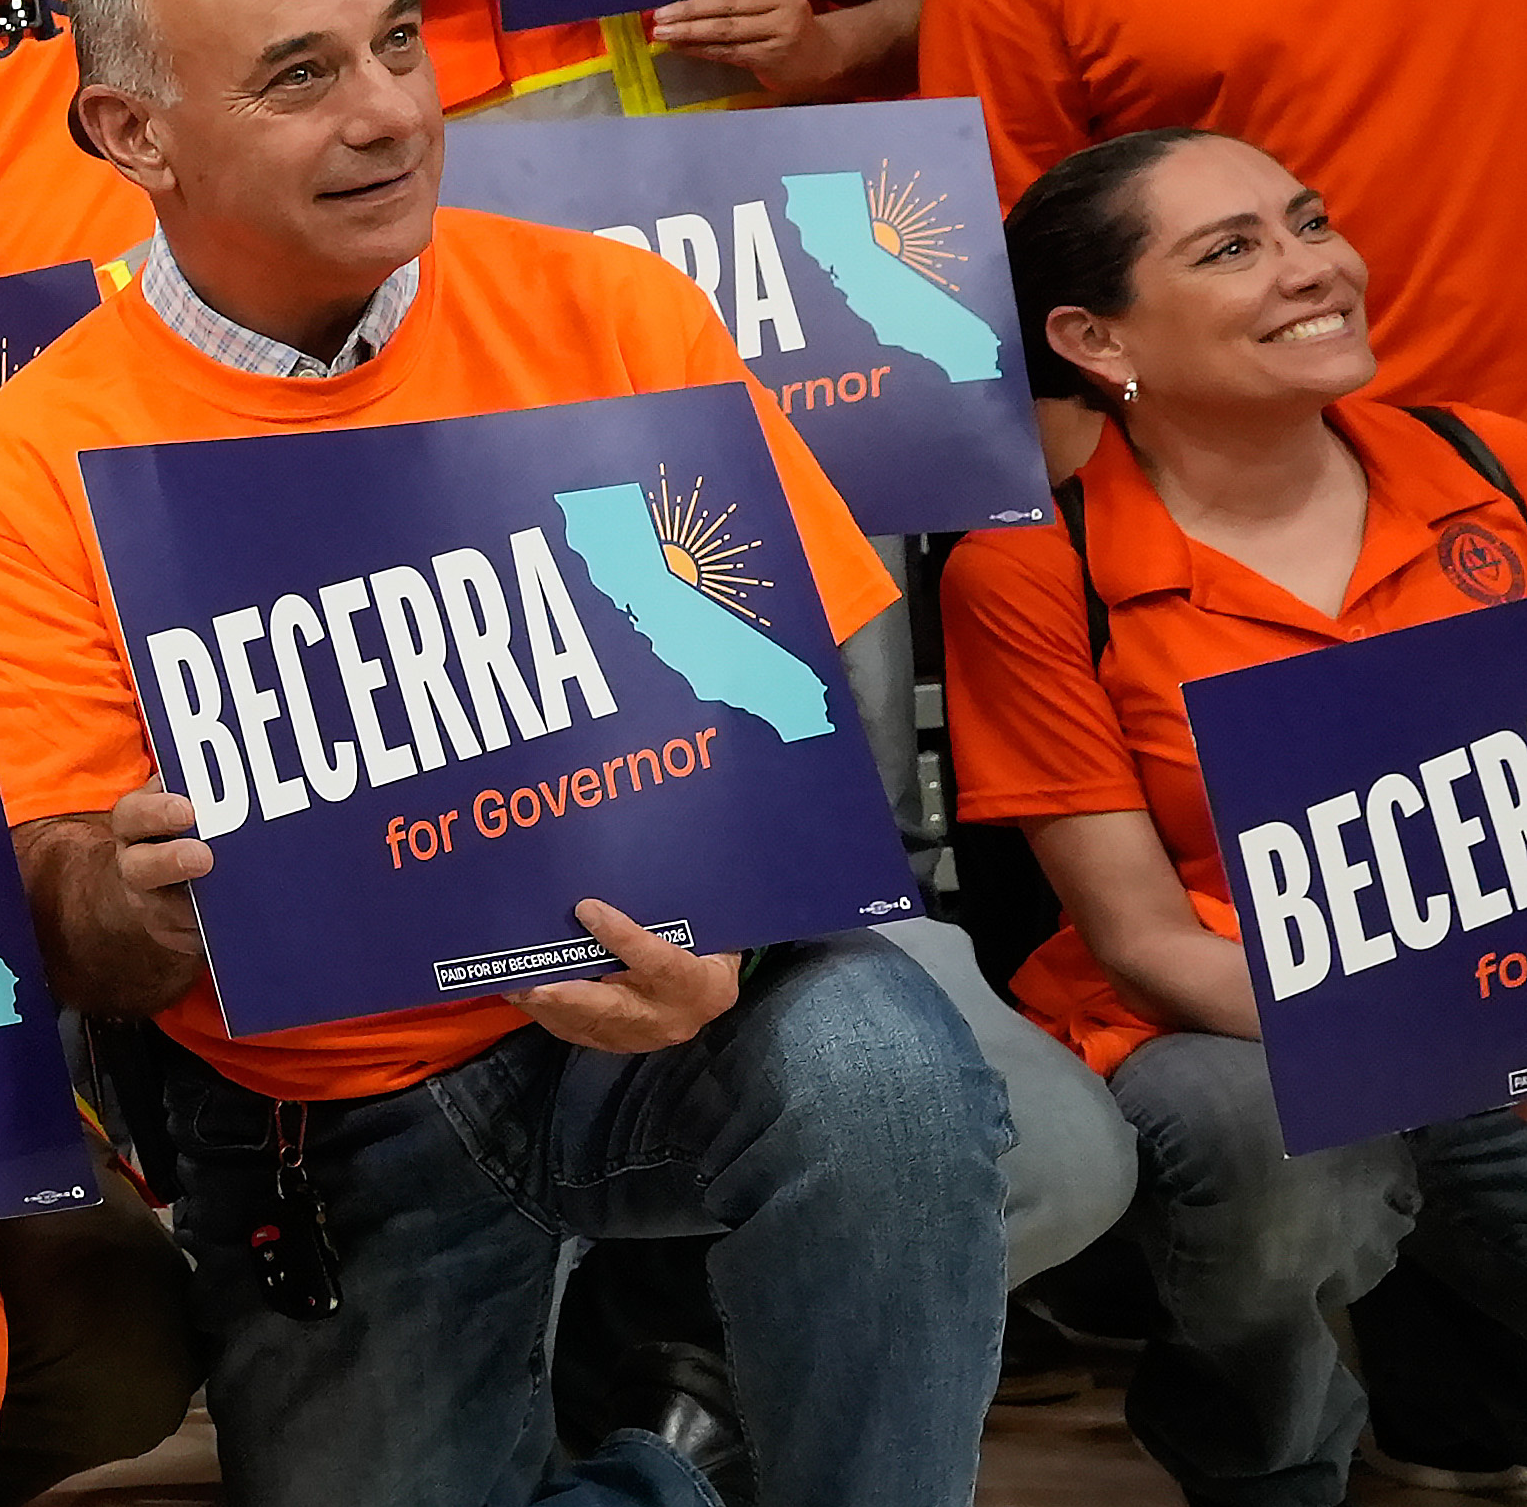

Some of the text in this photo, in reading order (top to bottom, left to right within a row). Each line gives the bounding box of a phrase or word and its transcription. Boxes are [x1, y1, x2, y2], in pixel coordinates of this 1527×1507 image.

[776, 366, 891, 415] rnor
[147, 527, 618, 840] BECERRA
[386, 728, 716, 868] for Governor
[1239, 731, 1527, 1001] BECER
[440, 967, 467, 983] PAID
[468, 963, 491, 979] FOR
[492, 959, 507, 974] BY
[509, 951, 562, 972] BECERRA
[563, 946, 588, 962] FOR
[1476, 953, 1527, 998] fo
